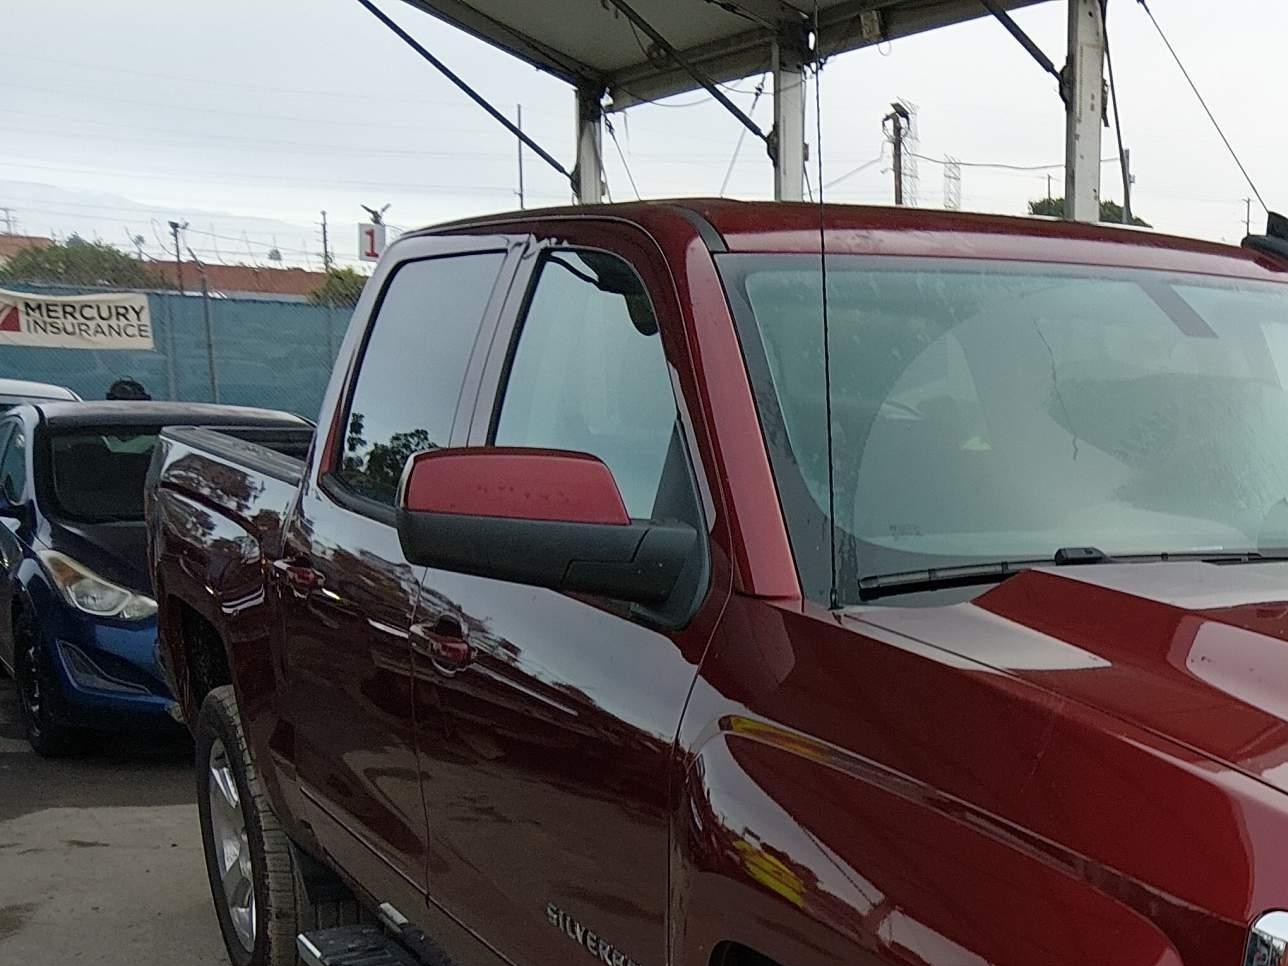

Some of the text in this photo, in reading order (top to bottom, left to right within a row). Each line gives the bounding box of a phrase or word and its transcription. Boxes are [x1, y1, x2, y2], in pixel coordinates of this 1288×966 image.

[365, 229, 379, 258] 1
[24, 302, 145, 322] MERCURY
[26, 319, 150, 338] INSURANCE
